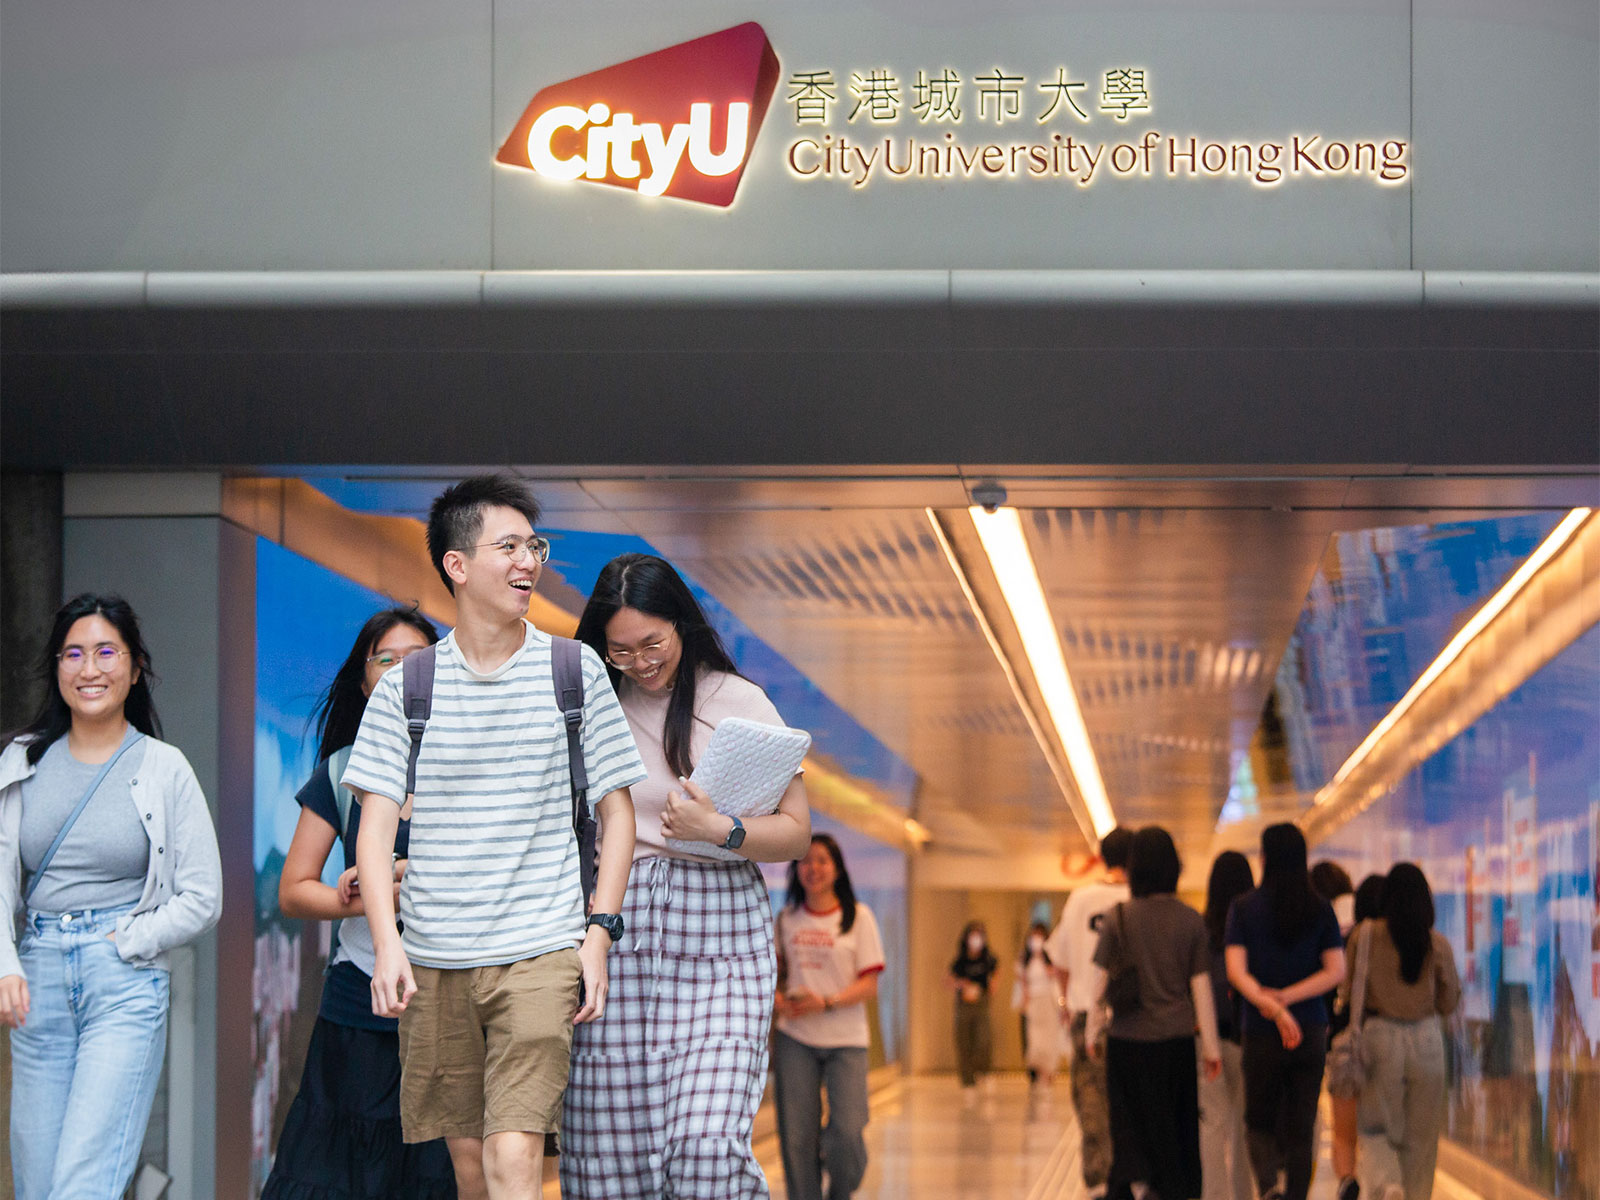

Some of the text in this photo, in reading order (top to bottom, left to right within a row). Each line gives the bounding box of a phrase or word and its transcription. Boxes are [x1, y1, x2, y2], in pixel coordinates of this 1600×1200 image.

[788, 68, 1148, 123] 香港城市大學
[527, 102, 750, 197] CityU
[789, 132, 1407, 186] City University of Hong Kong
